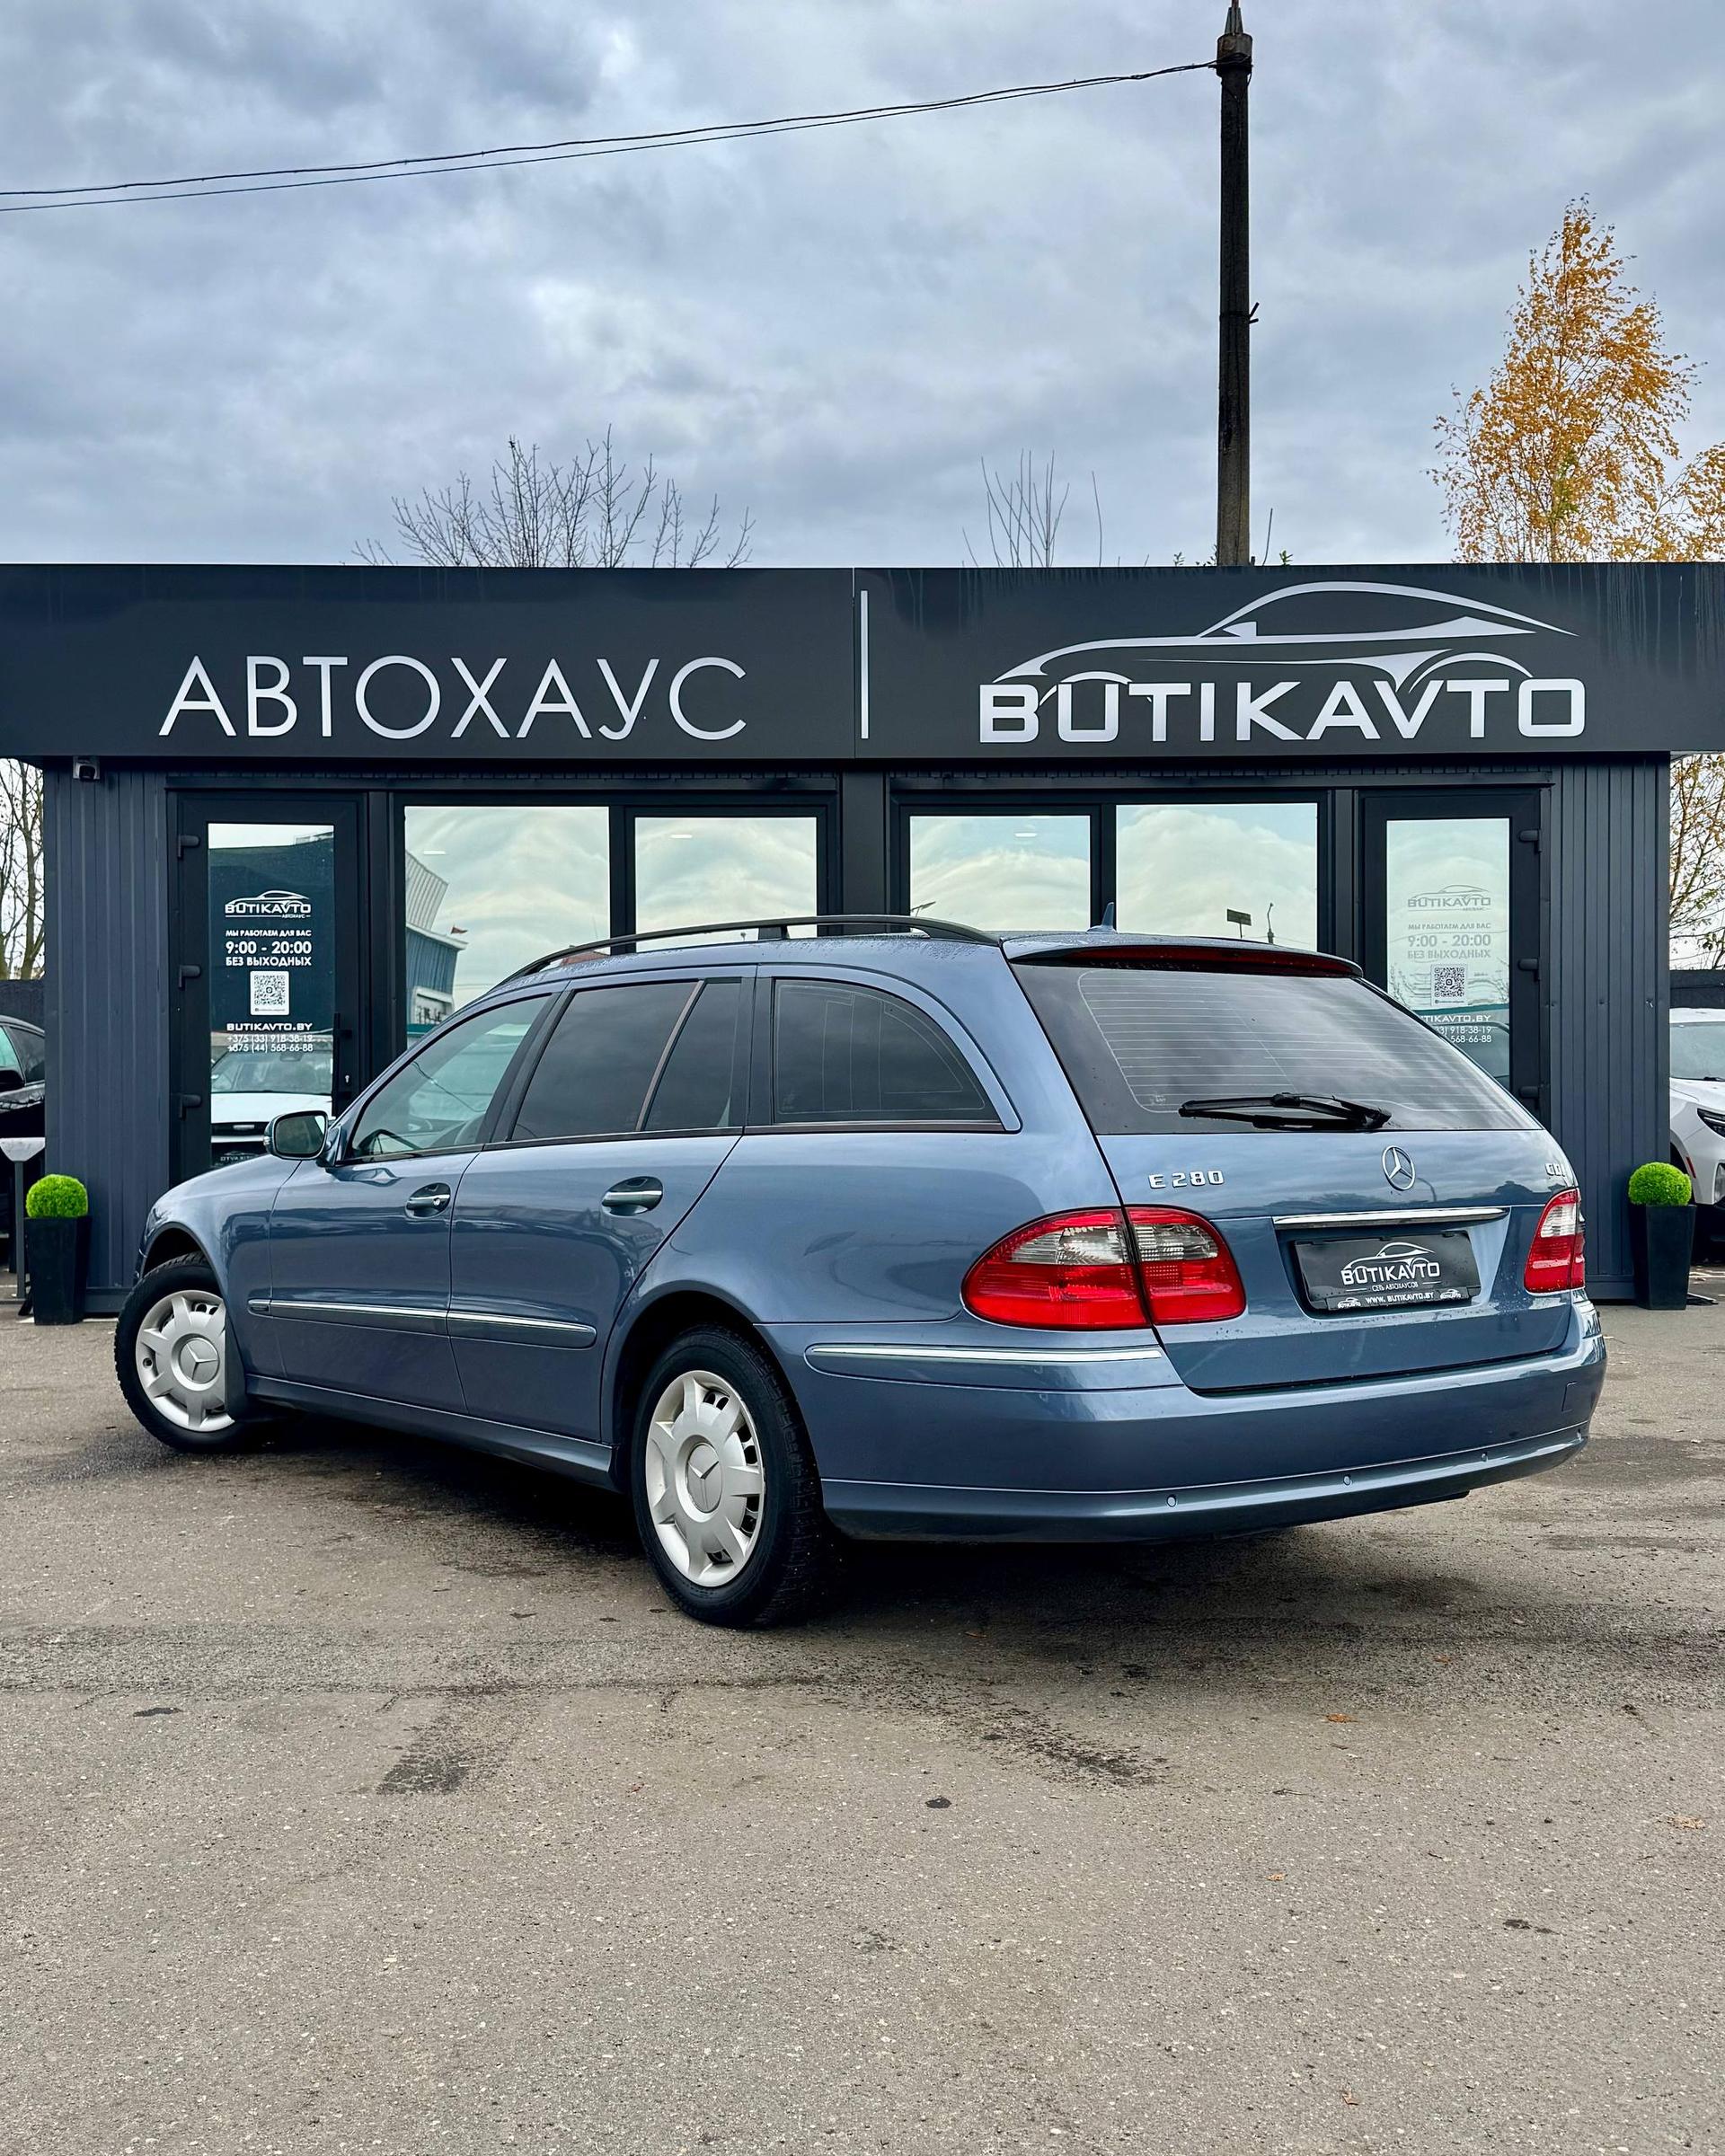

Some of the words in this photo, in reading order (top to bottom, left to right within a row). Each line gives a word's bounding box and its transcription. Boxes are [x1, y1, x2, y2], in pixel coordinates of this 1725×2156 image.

[158, 655, 748, 740] АВТОХАУС
[978, 677, 1587, 743] BUTIKAVTO
[1407, 897, 1491, 908] BUTIKAVTO
[225, 904, 312, 915] BUTIKAVTO
[1408, 935, 1438, 948] 9:00
[1451, 934, 1491, 947] 20:00
[226, 941, 257, 954] 9:00
[271, 941, 312, 954] 20:00
[1407, 950, 1425, 959] БЕЗ
[1428, 950, 1491, 959] ВЫХОДНЫХ
[226, 957, 244, 966] БЕЗ
[246, 957, 312, 967] ВЫХОДНЫХ
[226, 1023, 313, 1031] BUTIKAVTO.BY
[1450, 1026, 1492, 1034] 918-38-19
[227, 1035, 249, 1043] +375
[252, 1034, 268, 1044] (33)
[270, 1034, 314, 1043] 918-38-19
[1450, 1035, 1492, 1043] 568-66-88
[252, 1043, 268, 1054] (44)
[270, 1043, 314, 1052] 568-66-88
[1148, 1174, 1166, 1188] E
[1172, 1171, 1224, 1188] 280
[1340, 1262, 1441, 1286] BUTIKAVTO
